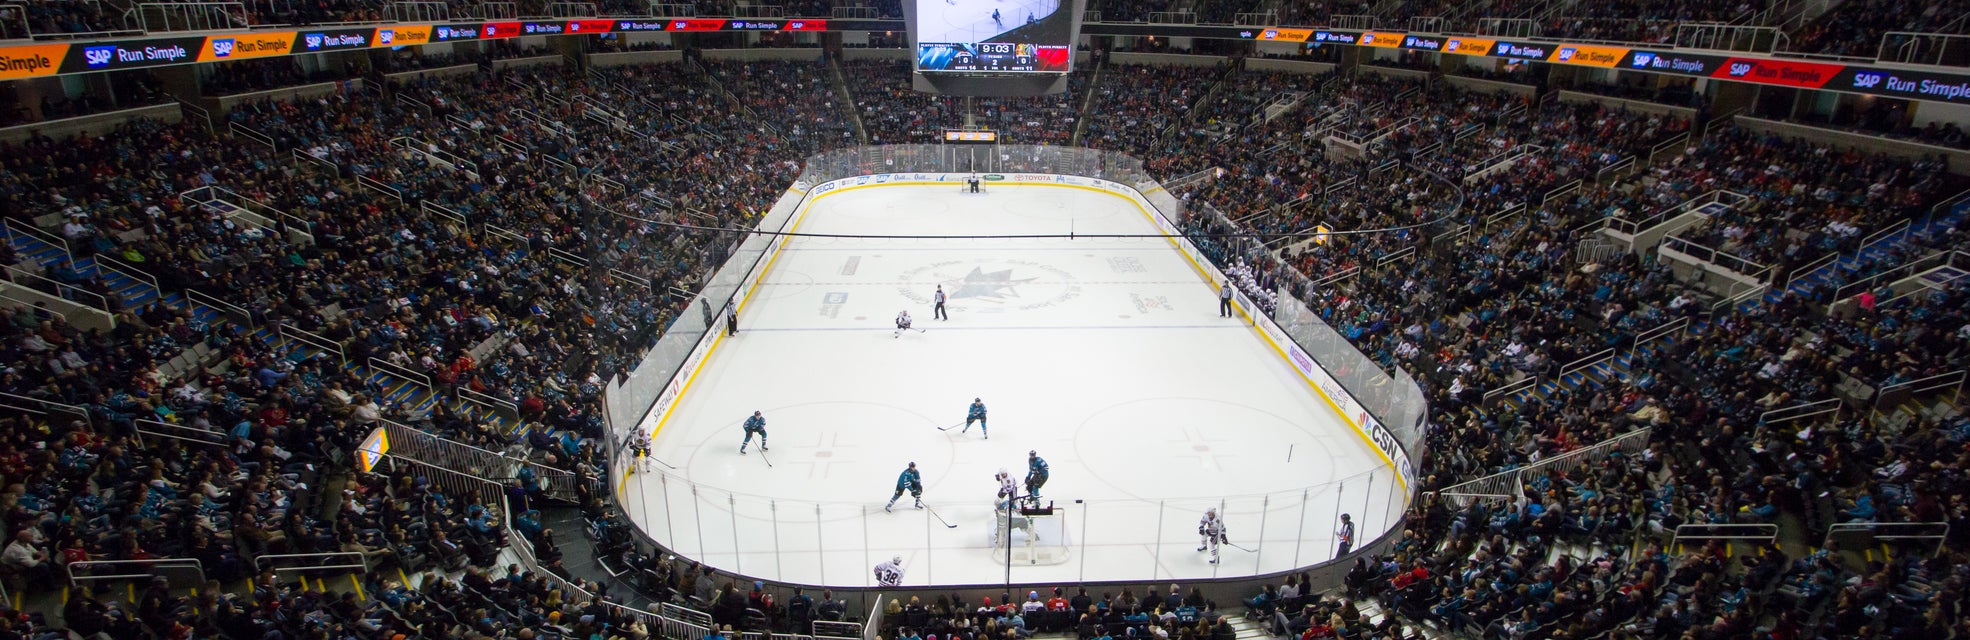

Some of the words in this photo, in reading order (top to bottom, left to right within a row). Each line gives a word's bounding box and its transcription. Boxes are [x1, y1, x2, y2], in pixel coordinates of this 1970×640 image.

[450, 28, 460, 38] Run
[461, 27, 477, 37] Simple
[536, 24, 546, 33] Run
[546, 23, 562, 32] Simple
[621, 22, 631, 30] SAP
[632, 22, 642, 30] Run
[642, 22, 661, 31] Simple
[756, 22, 777, 30] Simple
[306, 35, 323, 48] SAP
[324, 35, 340, 46] Run
[341, 33, 365, 45] Simple
[380, 32, 393, 43] SAP
[395, 33, 408, 41] Run
[408, 30, 426, 41] Simple
[1265, 31, 1276, 39] SAP
[1287, 32, 1304, 40] Simple
[1339, 34, 1354, 43] Simple
[1383, 37, 1397, 45] Simple
[213, 42, 232, 55] SAP
[237, 41, 256, 52] Run
[258, 38, 287, 51] Simple
[983, 44, 1009, 54] 9:03
[1406, 38, 1415, 46] SAP
[1424, 40, 1438, 49] Simple
[1449, 41, 1458, 49] SAP
[1459, 42, 1469, 50] Run
[1470, 43, 1486, 52] Simple
[86, 48, 112, 65] SAP
[117, 48, 144, 62] Run
[145, 45, 187, 61] Simple
[1497, 44, 1509, 54] SAP
[1510, 46, 1521, 55] Run
[1522, 46, 1544, 58] Simple
[1559, 49, 1573, 59] SAP
[1574, 49, 1588, 59] Run
[1590, 50, 1615, 63] Simple
[0, 54, 50, 72] Simple
[1633, 54, 1650, 67] SAP
[1652, 57, 1671, 68] Run
[1672, 59, 1704, 73] Simple
[1730, 64, 1751, 75] SAP
[1755, 65, 1778, 78] Run
[1780, 67, 1821, 83] Simple
[1853, 73, 1881, 88] SAP
[1886, 76, 1916, 92] Run
[1919, 79, 1970, 99] Simple
[815, 182, 835, 194] GEICO
[1321, 382, 1346, 411] AMERICA
[653, 390, 673, 423] SAFEWAY
[1372, 424, 1398, 462] CSN
[883, 569, 899, 584] 38
